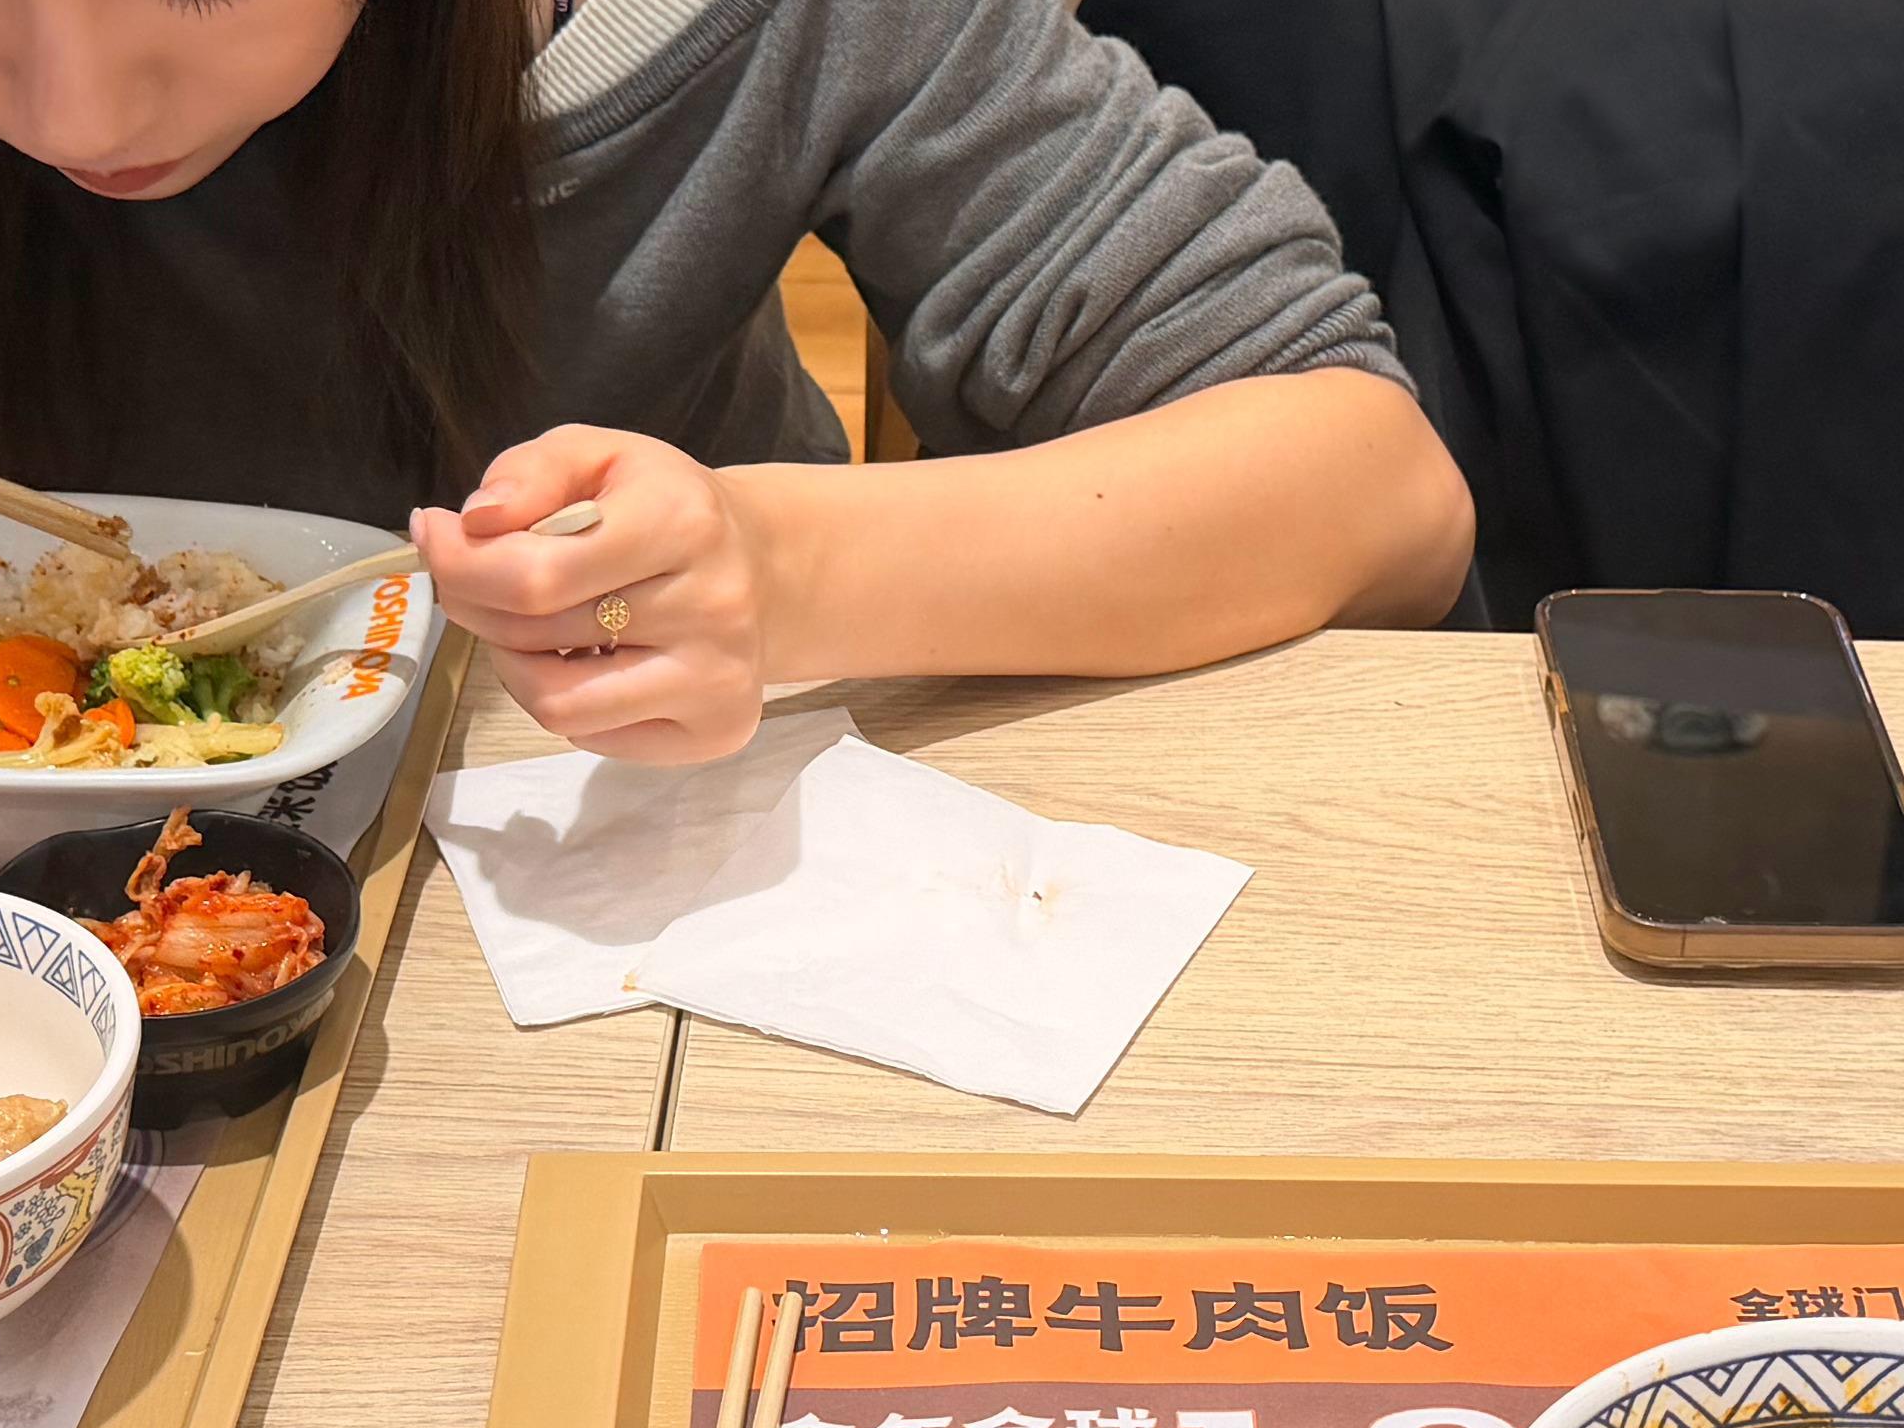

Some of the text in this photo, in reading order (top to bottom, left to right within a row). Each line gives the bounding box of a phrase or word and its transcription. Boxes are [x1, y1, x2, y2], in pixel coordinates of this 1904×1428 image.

[772, 1275, 1454, 1353] 招牌牛肉饭
